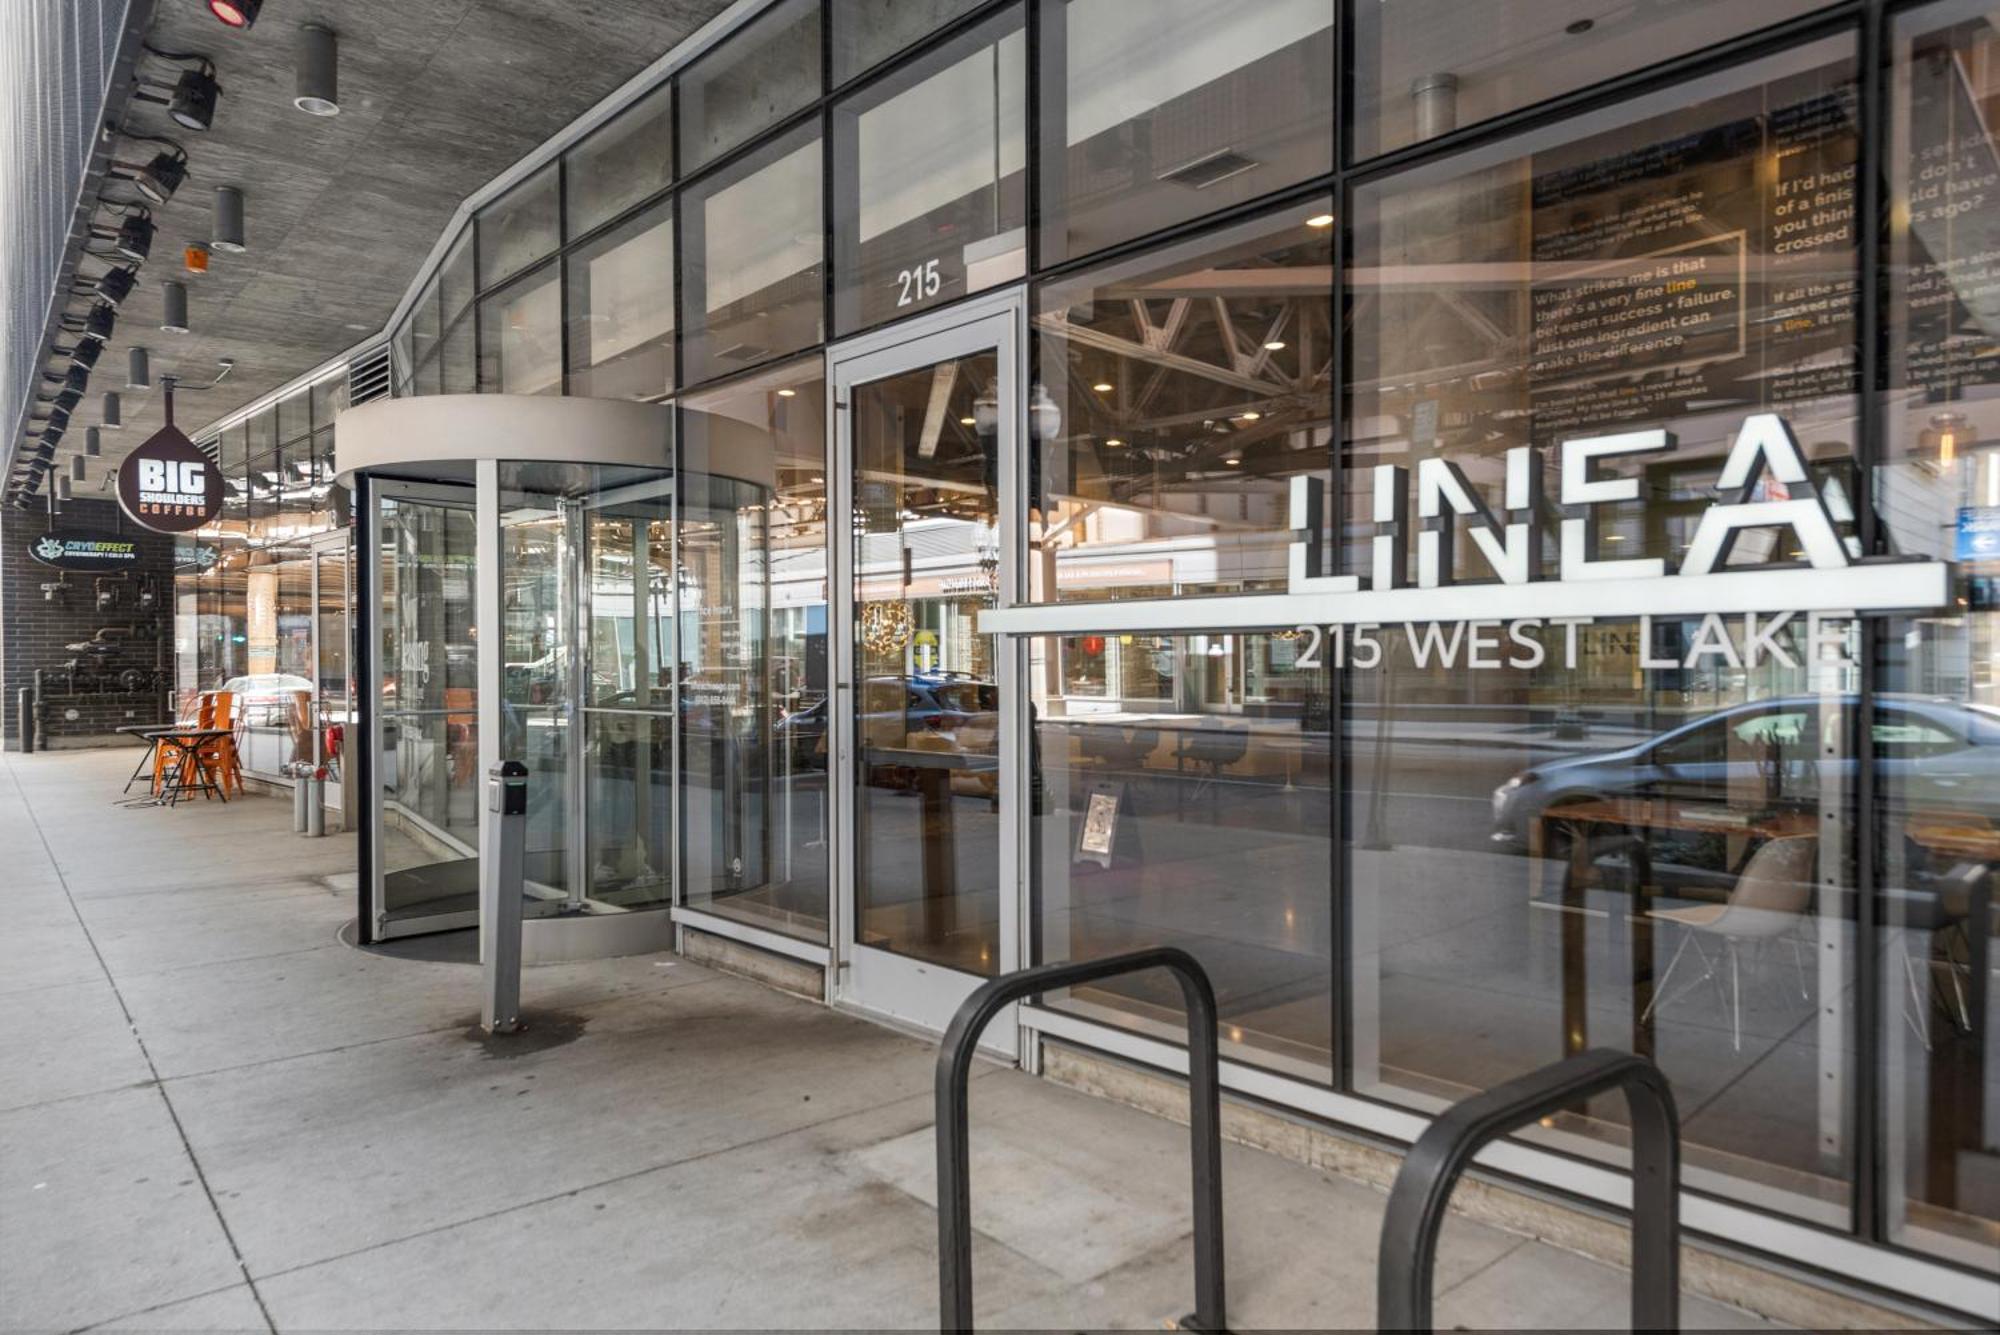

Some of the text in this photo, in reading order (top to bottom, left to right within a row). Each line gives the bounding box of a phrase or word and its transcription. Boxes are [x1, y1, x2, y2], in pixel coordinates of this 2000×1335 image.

[1920, 155, 1976, 182] don't
[1793, 174, 1816, 195] I'd
[1945, 173, 1998, 196] have
[1775, 186, 1854, 217] of a finis
[1931, 194, 1984, 219] ago?
[1773, 218, 1807, 240] you
[1774, 226, 1849, 254] crossed
[897, 259, 941, 307] 215
[1534, 257, 1706, 306] What strikes me is that
[1807, 283, 1833, 298] the
[1535, 277, 1698, 323] there's a very fine line
[1535, 288, 1737, 339] between success failure.
[1535, 311, 1712, 356] Just one ingredient can
[1577, 344, 1601, 363] the
[138, 458, 205, 494] BIG
[139, 491, 206, 506] SHOULDERS
[139, 503, 207, 517] COFFEE
[1288, 413, 1850, 594] LINEA
[64, 541, 135, 553] CRYOEFFECT
[1294, 609, 1857, 670] 215 WEST LAKE
